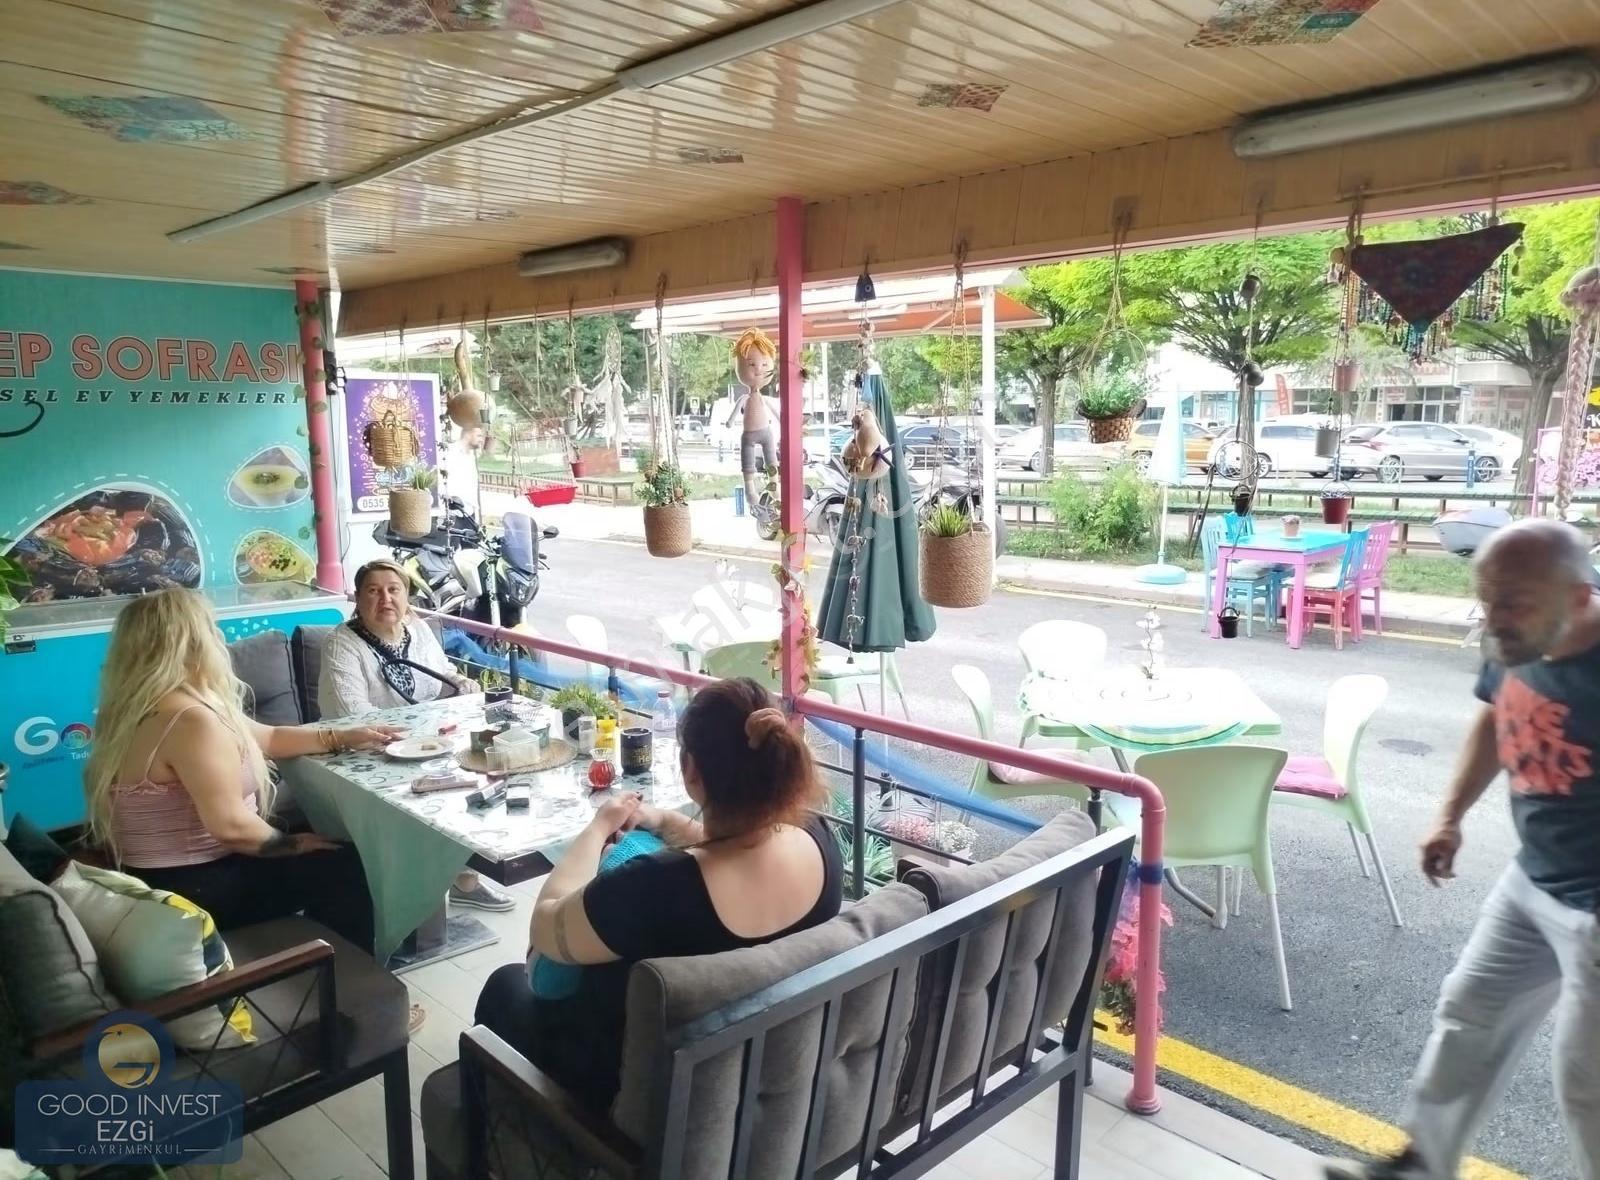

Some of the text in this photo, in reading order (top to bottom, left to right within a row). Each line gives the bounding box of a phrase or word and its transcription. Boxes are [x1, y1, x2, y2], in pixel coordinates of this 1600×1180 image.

[71, 333, 300, 384] SOFRASI
[76, 390, 112, 403] EV
[362, 497, 384, 509] 0535
